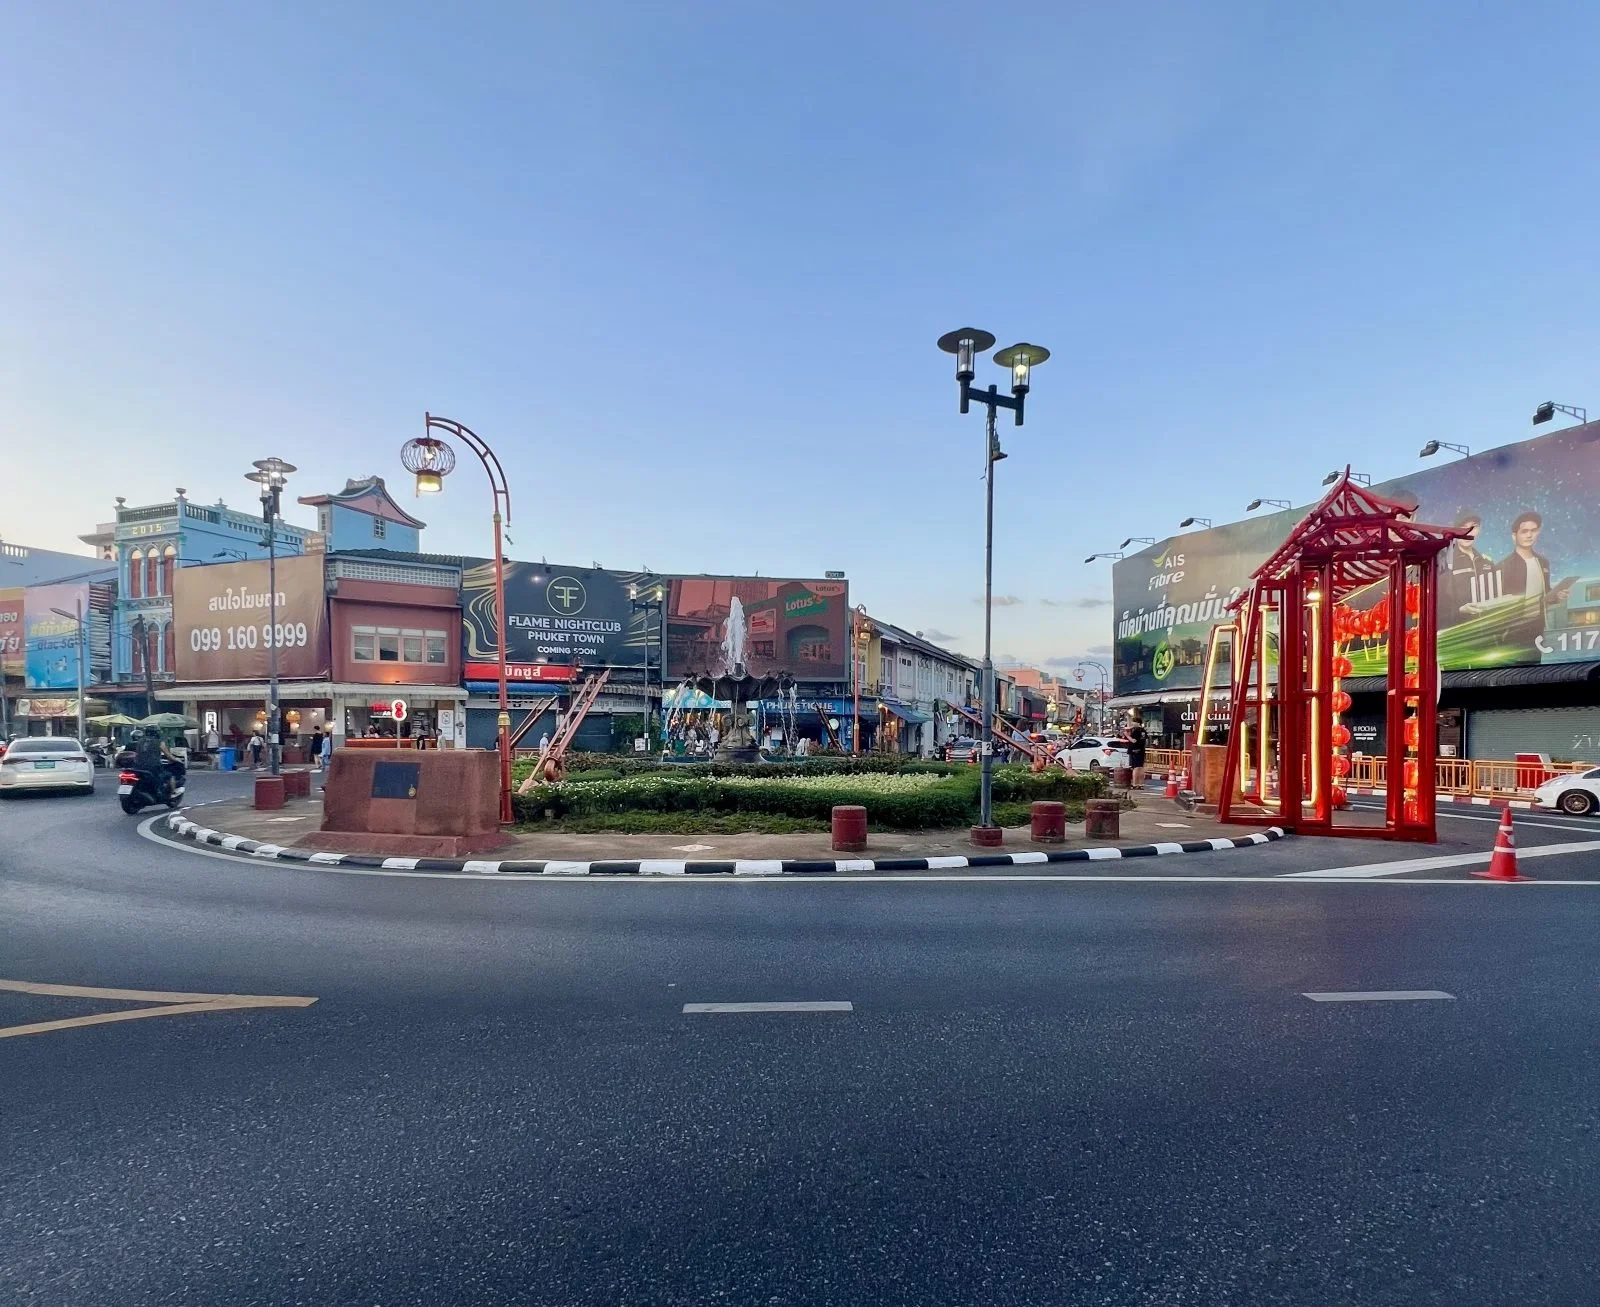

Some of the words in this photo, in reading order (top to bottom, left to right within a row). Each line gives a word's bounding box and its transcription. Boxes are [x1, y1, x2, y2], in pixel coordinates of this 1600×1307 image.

[132, 524, 161, 535] 2015
[1165, 554, 1185, 569] AIS
[1148, 571, 1185, 590] Fibre
[508, 615, 550, 628] FLAME
[554, 618, 622, 632] NIGHTCLUB
[190, 628, 222, 651] 099
[227, 626, 258, 650] 160
[263, 622, 307, 649] 9999
[527, 630, 570, 642] PHUKET
[573, 633, 605, 643] TOWN
[537, 645, 571, 655] COMING
[573, 647, 597, 656] SOON
